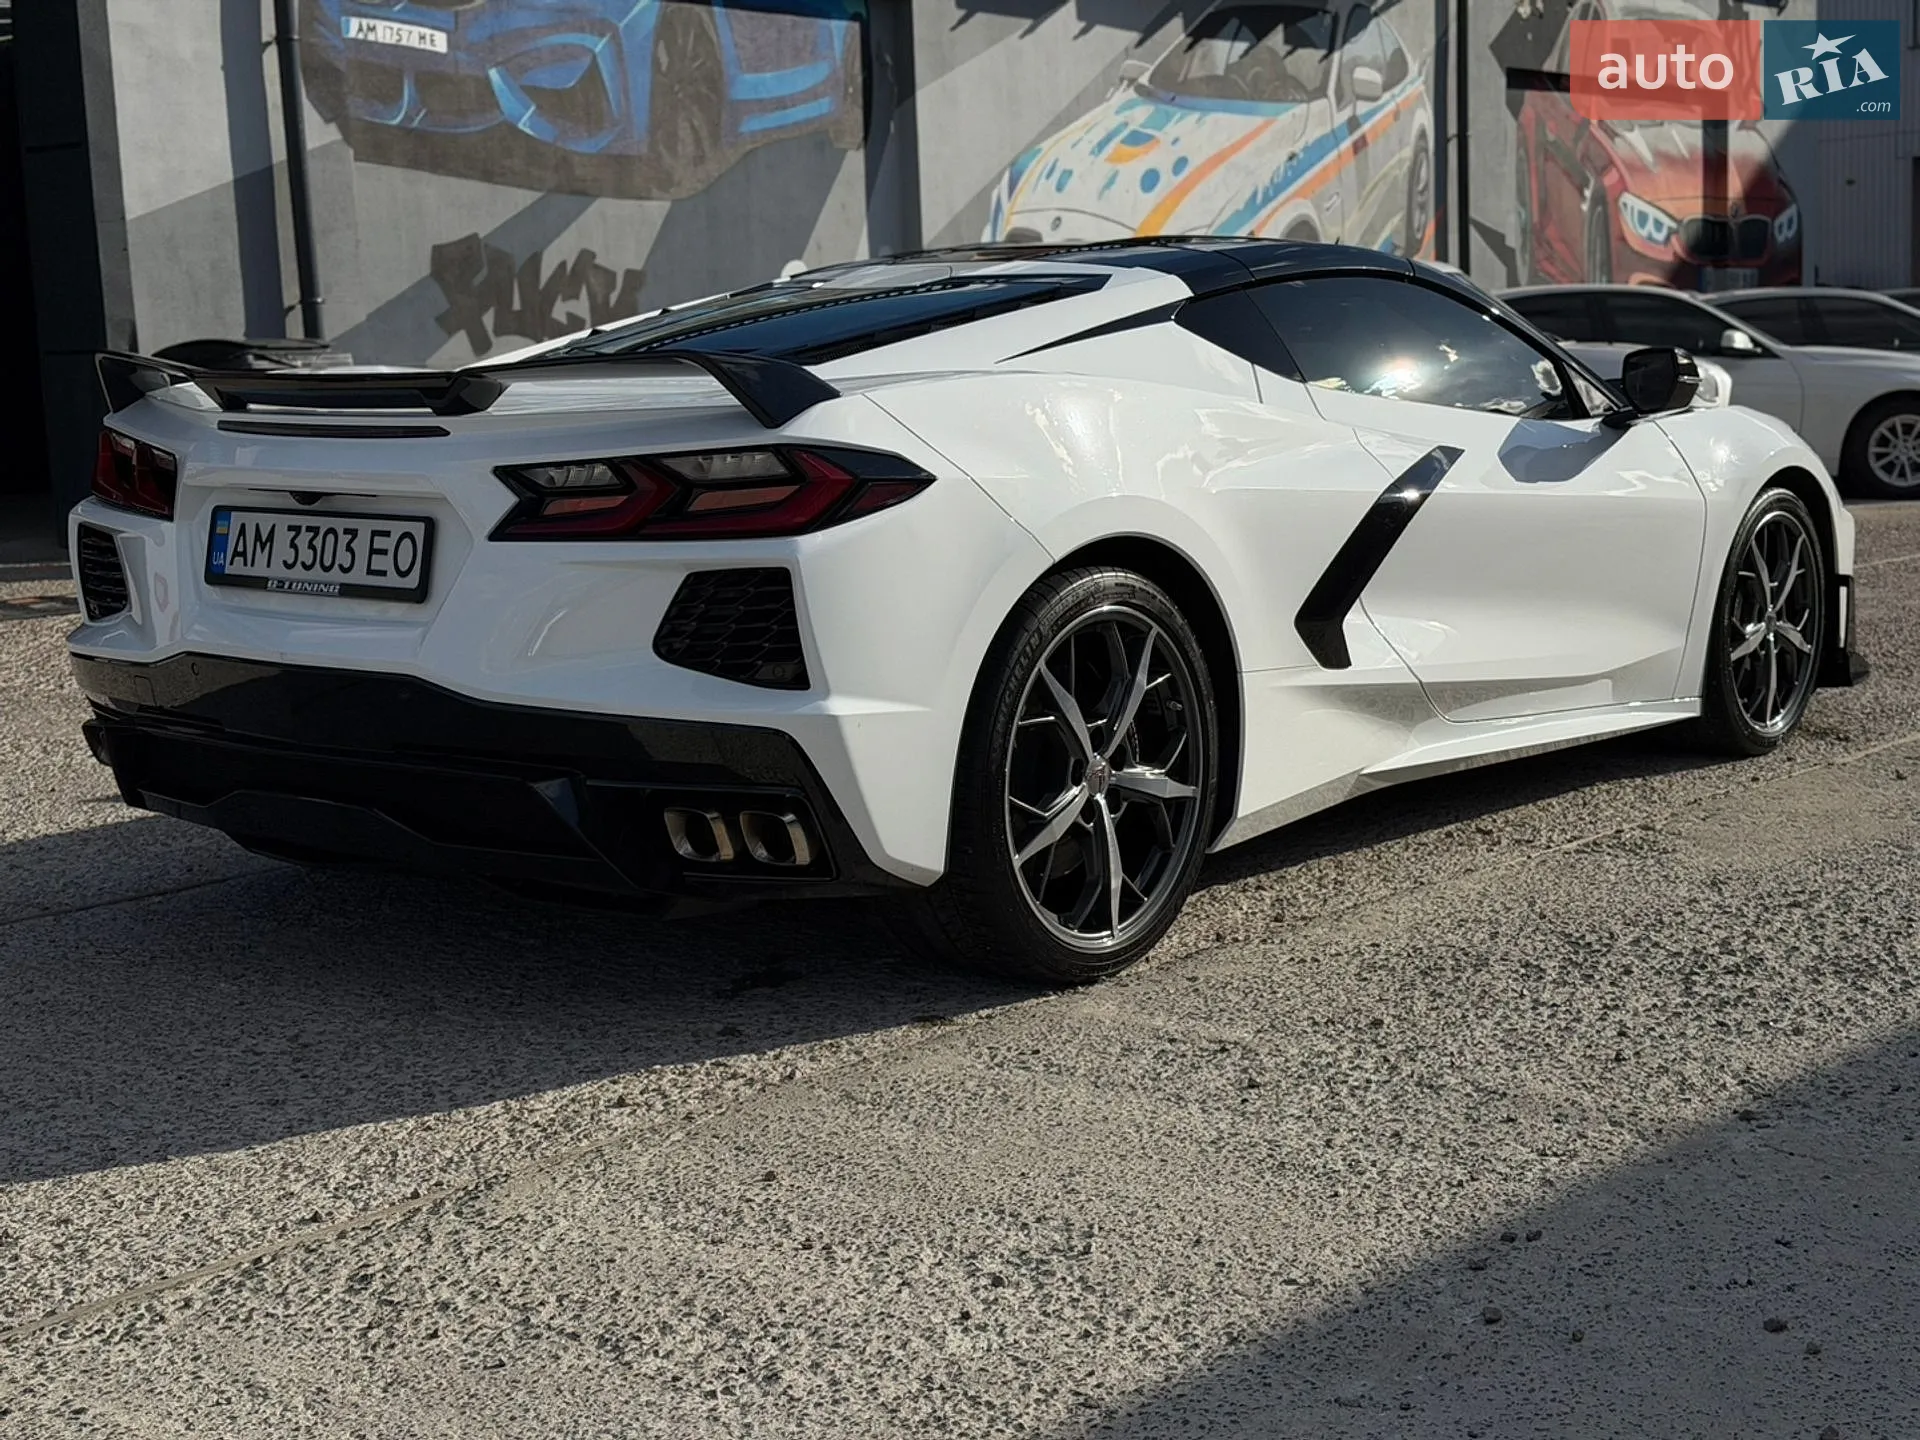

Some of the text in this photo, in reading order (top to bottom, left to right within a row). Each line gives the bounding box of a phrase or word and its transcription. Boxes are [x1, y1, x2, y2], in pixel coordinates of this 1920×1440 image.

[355, 20, 379, 41] AM
[211, 551, 225, 566] UA
[229, 522, 418, 579] AM 3303 EO
